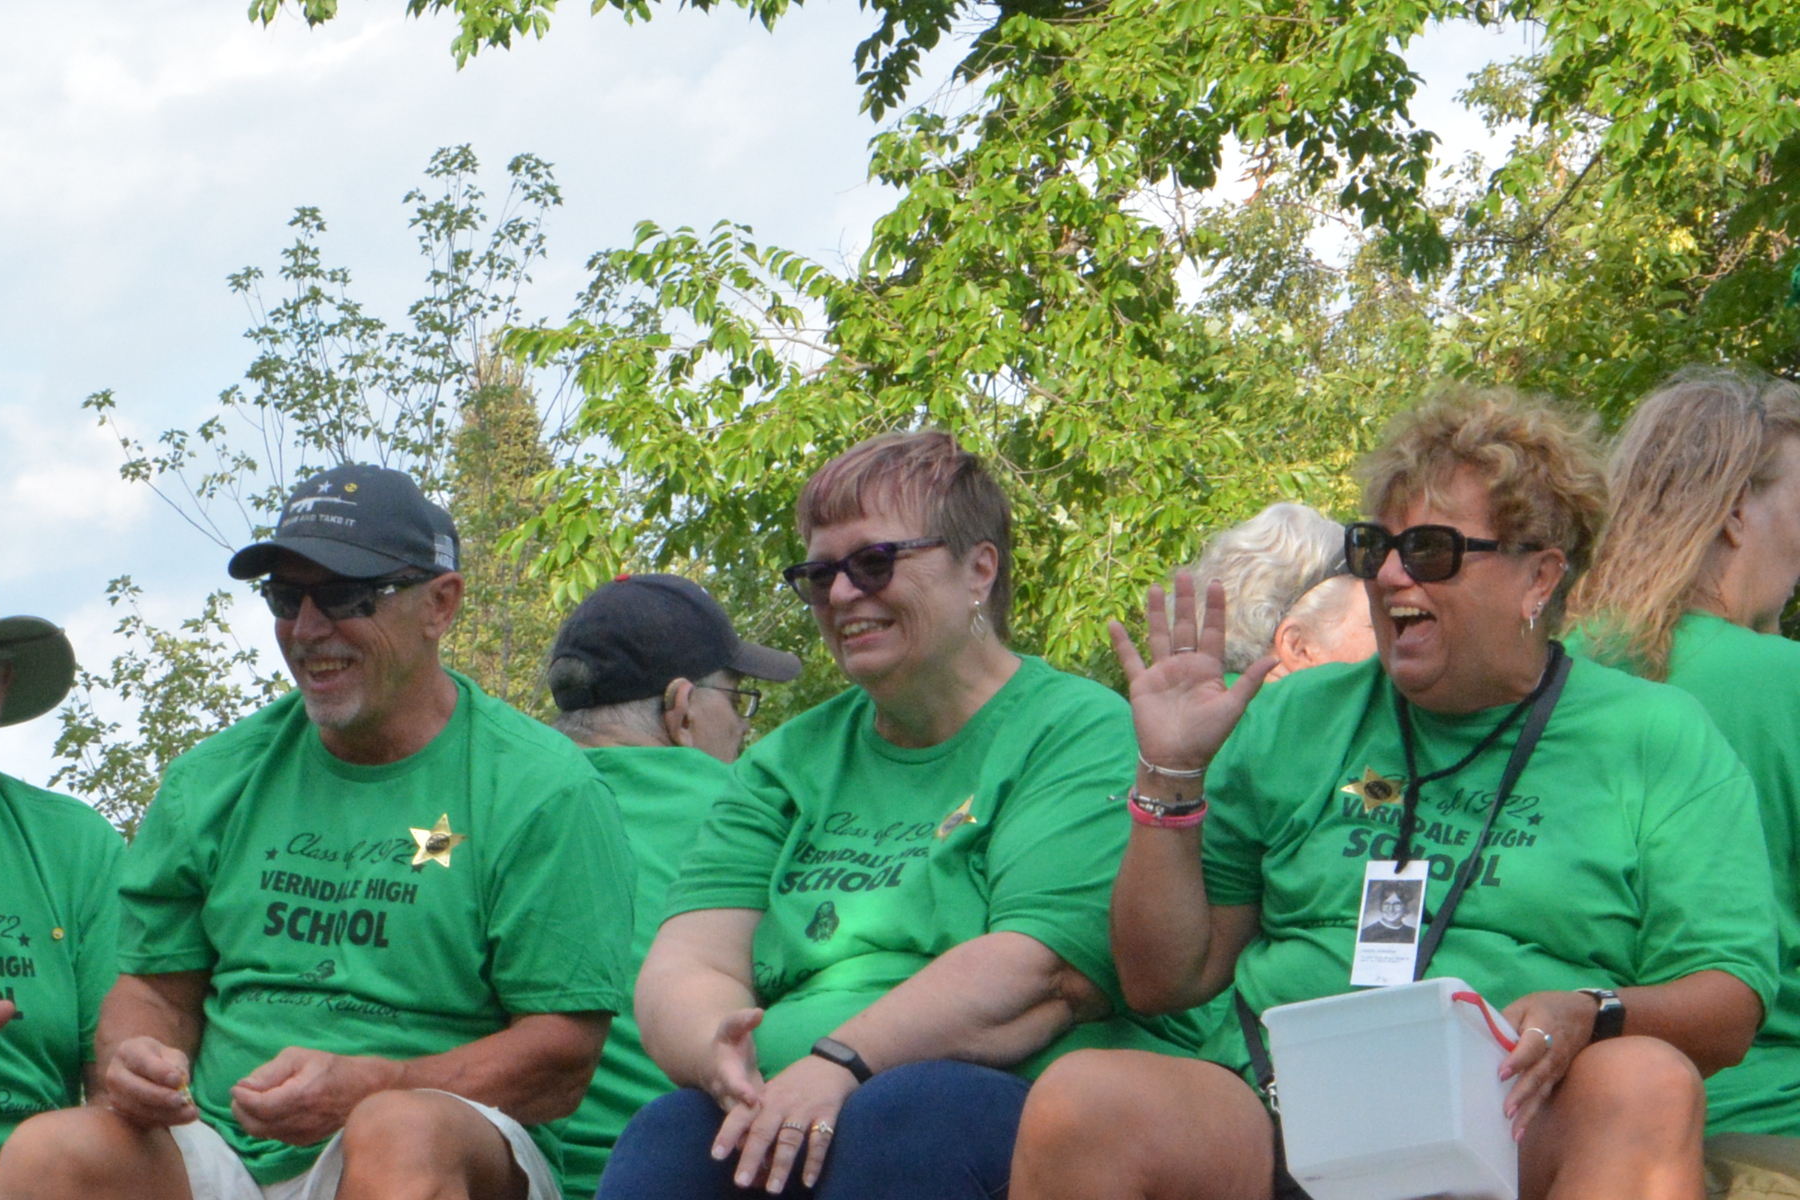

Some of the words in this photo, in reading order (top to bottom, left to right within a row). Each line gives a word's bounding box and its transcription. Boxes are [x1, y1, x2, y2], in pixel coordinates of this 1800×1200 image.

[824, 812, 869, 837] Class
[873, 821, 903, 847] of
[286, 832, 338, 863] Class
[260, 870, 362, 904] VERNDALE
[364, 878, 418, 905] HIGH
[778, 862, 906, 895] SCHOOL
[263, 902, 389, 948] SCHOOL
